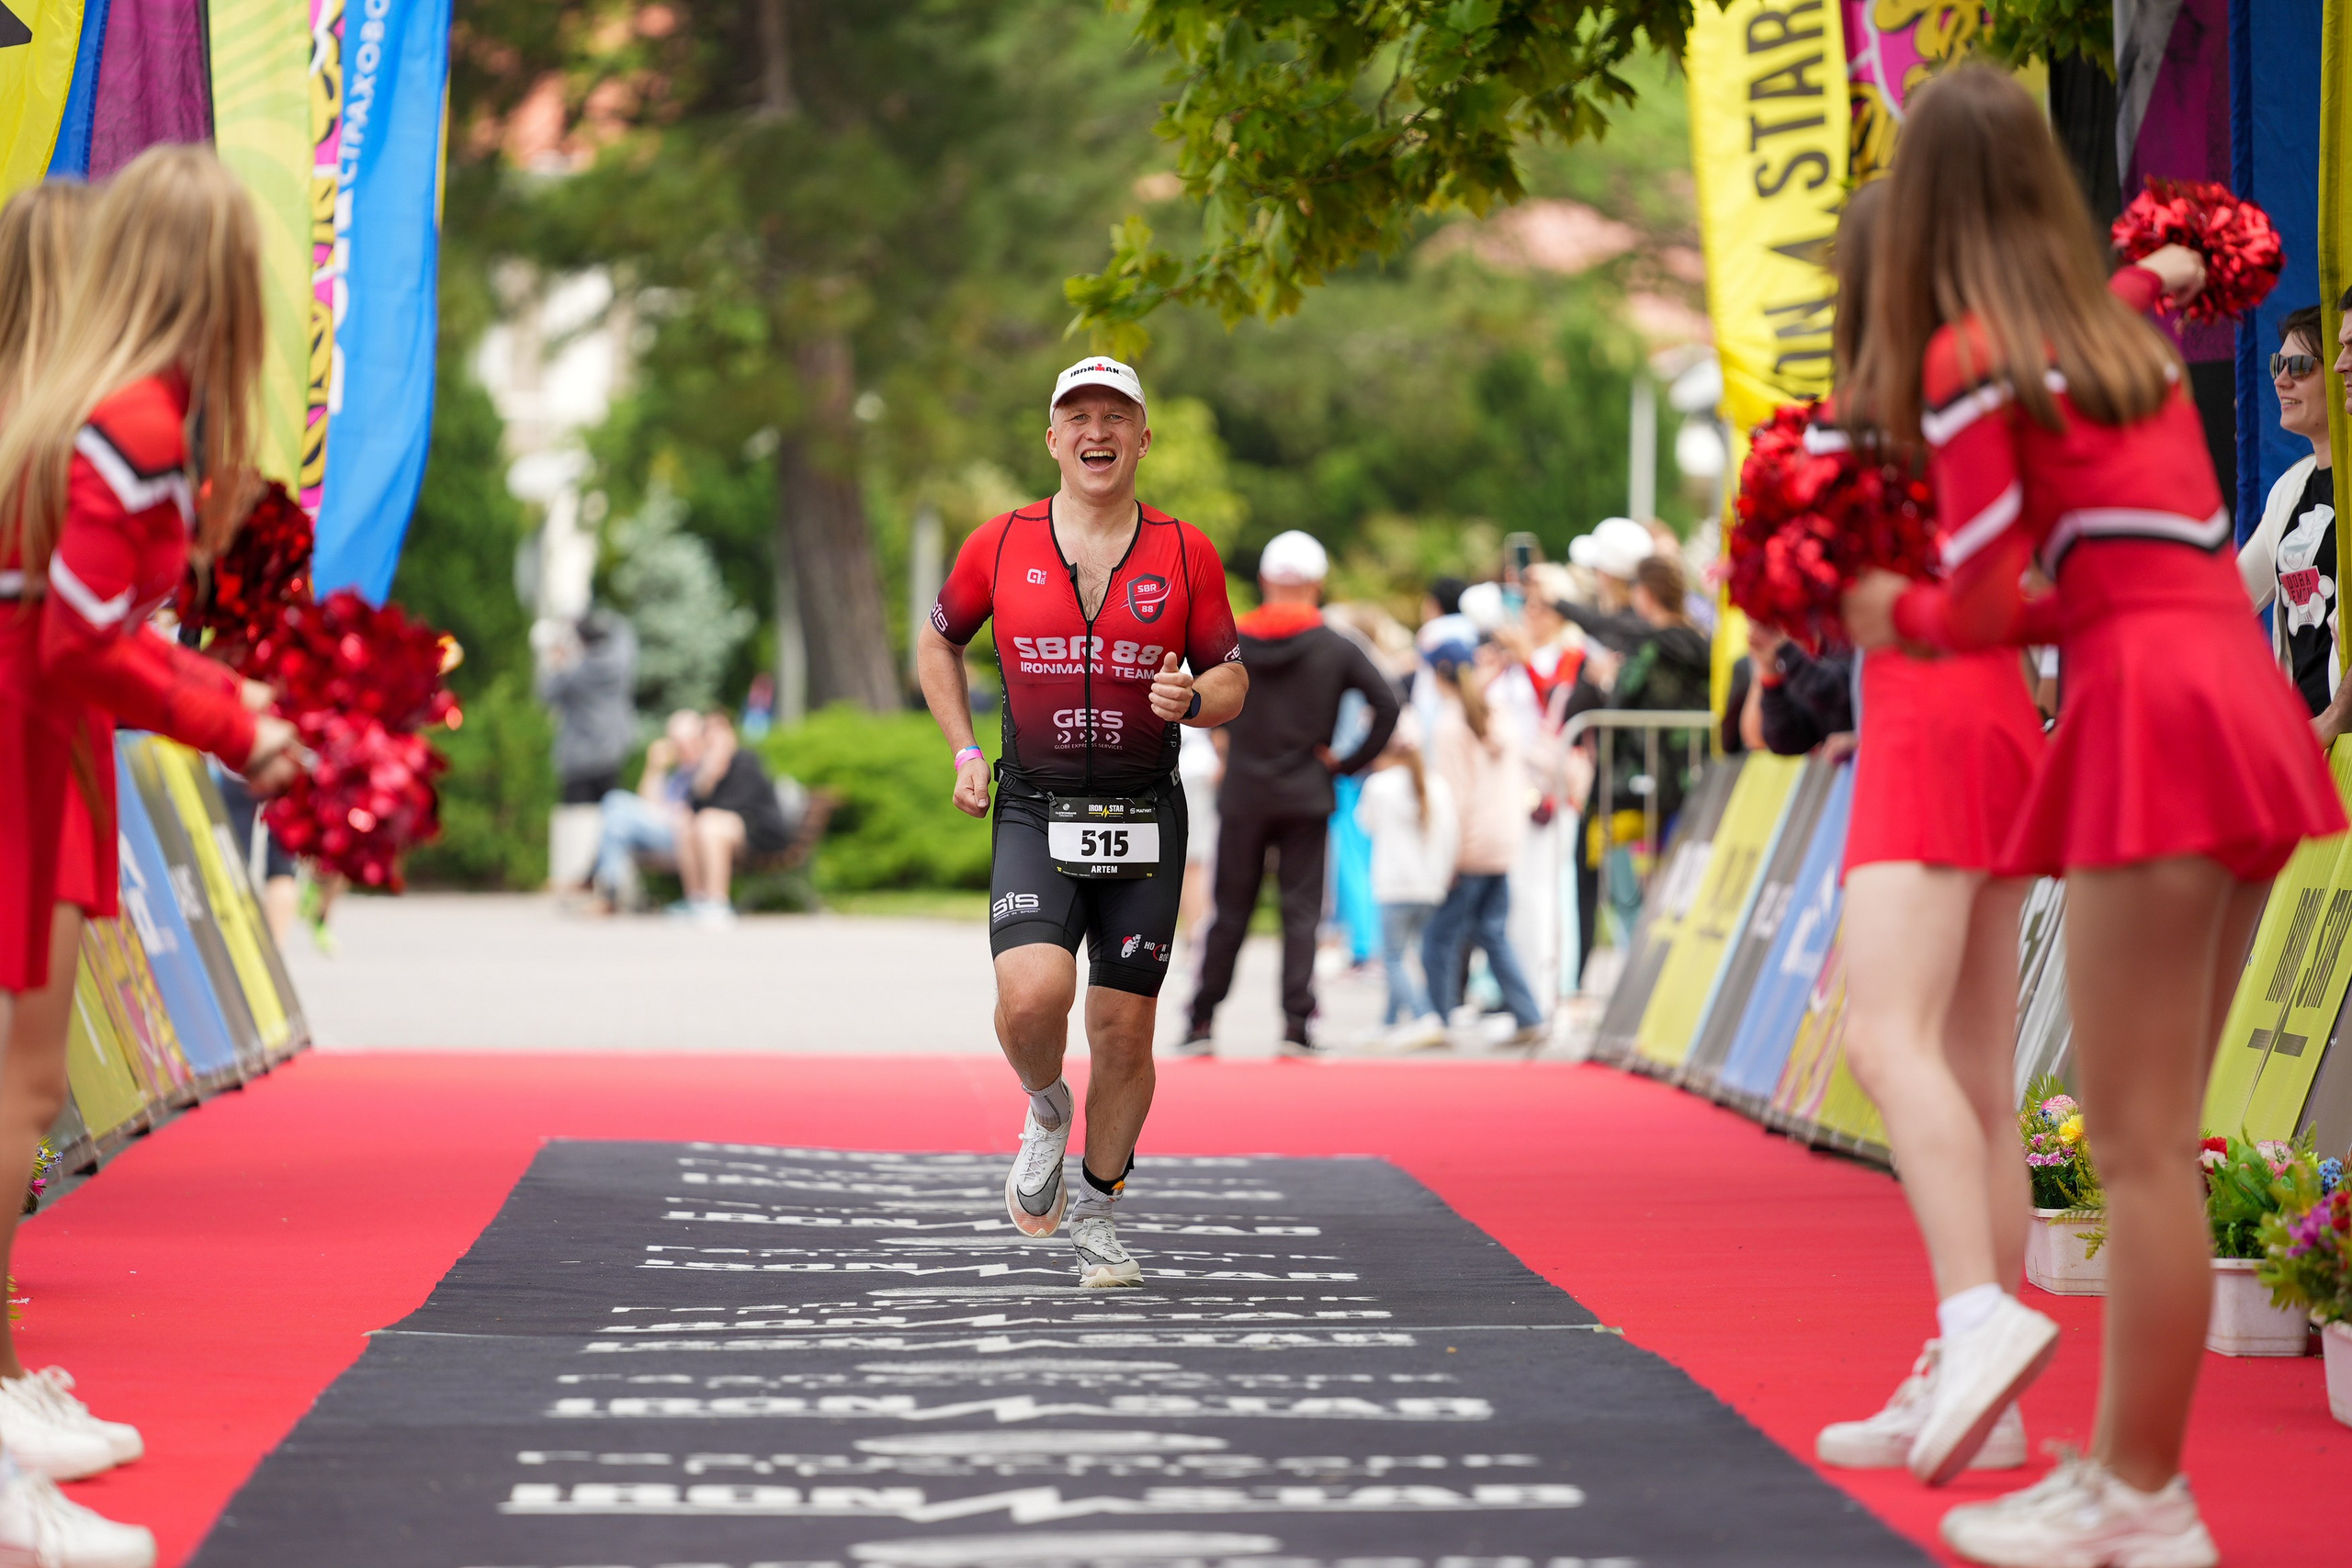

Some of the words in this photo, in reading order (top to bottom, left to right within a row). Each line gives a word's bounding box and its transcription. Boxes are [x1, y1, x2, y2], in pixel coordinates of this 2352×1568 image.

[1747, 0, 1830, 197] STAR
[1070, 364, 1120, 378] IRONMAN
[1137, 583, 1157, 593] SBR
[2287, 572, 2312, 590] DORA
[1012, 635, 1104, 660] SBR
[1111, 639, 1164, 666] 88
[1020, 660, 1104, 674] IRONMAN
[1111, 665, 1155, 680] TEAM
[1053, 707, 1124, 729] GES
[1088, 804, 1102, 812] IRON
[1108, 804, 1125, 813] STAR
[1080, 829, 1129, 857] 515
[1091, 865, 1118, 874] ARTEM
[668, 1211, 918, 1226] IRON
[645, 1259, 918, 1270] IRON
[603, 1316, 906, 1331] IRON
[1071, 1311, 1393, 1320] STAR
[584, 1337, 906, 1351] IRON
[1078, 1332, 1416, 1347] STAR
[555, 1394, 916, 1416] IRON
[1110, 1394, 1492, 1416] STAR
[509, 1482, 924, 1507] IRON
[1145, 1483, 1586, 1507] STAR
